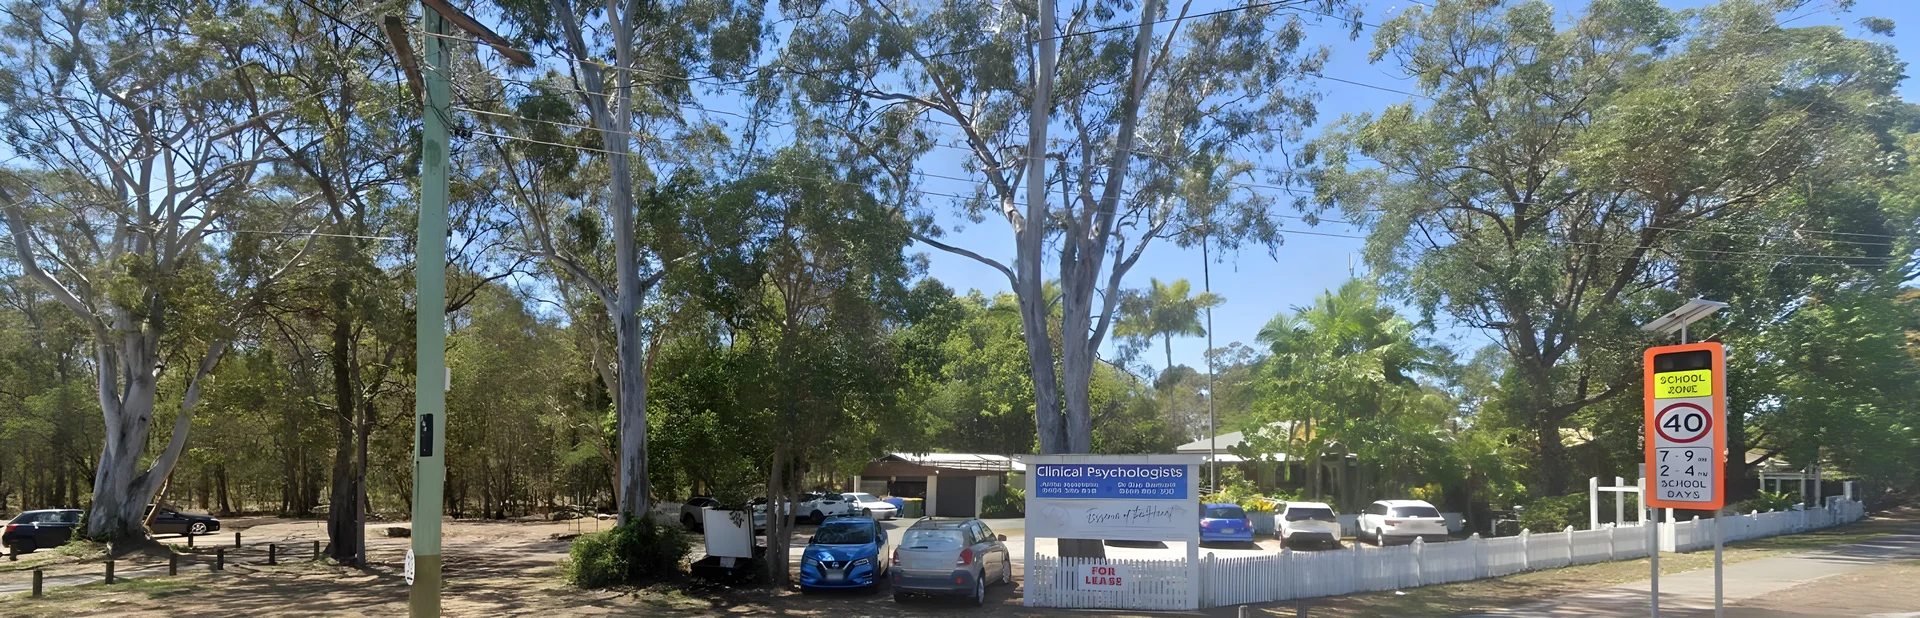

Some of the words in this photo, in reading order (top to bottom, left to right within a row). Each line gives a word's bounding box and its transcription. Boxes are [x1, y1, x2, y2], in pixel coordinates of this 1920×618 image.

[1660, 374, 1706, 384] SCHOOL
[1667, 385, 1698, 394] ZONE
[1663, 413, 1703, 433] 40
[1660, 450, 1670, 462] 7
[1684, 450, 1694, 462] 9
[1037, 466, 1082, 477] Clinical
[1087, 466, 1183, 480] Psychologists
[1660, 465, 1670, 477] 2
[1684, 465, 1695, 477] 4
[1661, 480, 1707, 488] SCHOOL
[1667, 490, 1700, 499] DAYS
[1091, 566, 1116, 575] FOR
[1085, 576, 1122, 586] LEASE
